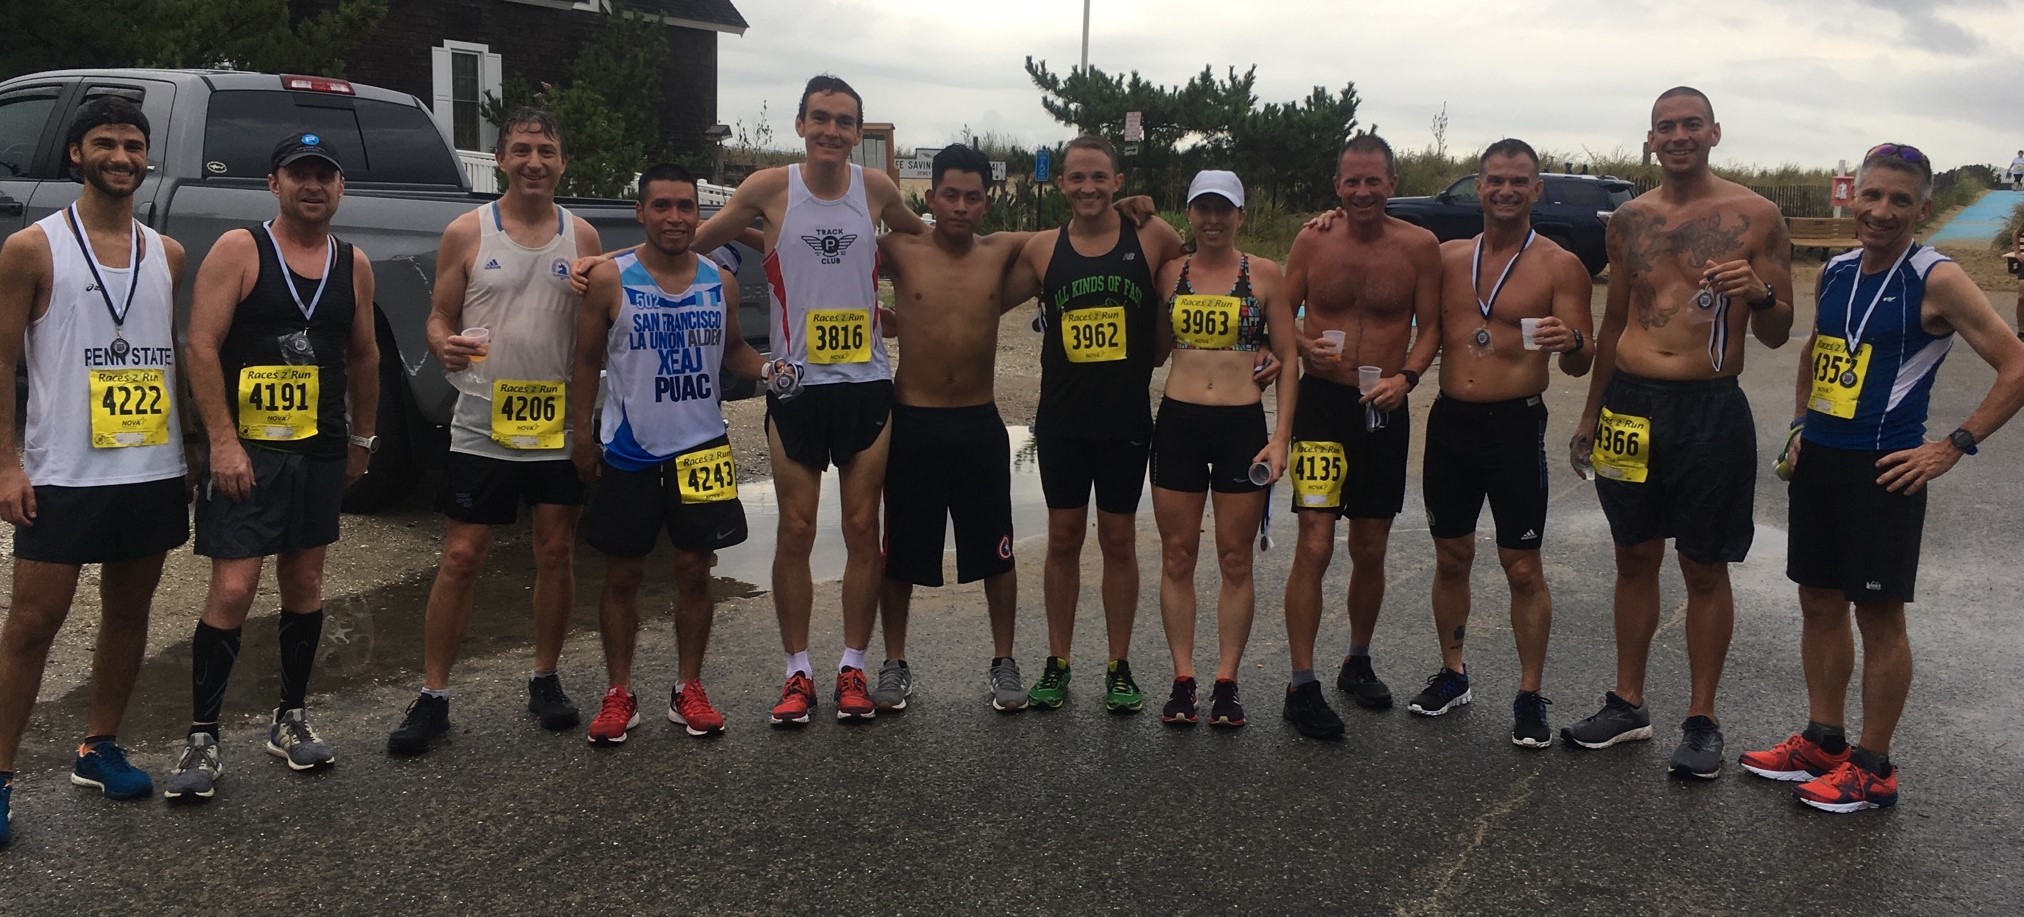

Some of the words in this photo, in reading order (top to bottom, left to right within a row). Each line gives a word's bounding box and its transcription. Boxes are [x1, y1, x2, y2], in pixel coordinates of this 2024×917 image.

[816, 228, 844, 236] TRACK
[635, 293, 660, 310] 502
[1055, 286, 1069, 311] ALL
[1072, 275, 1104, 298] KINDS
[1107, 275, 1121, 292] OF
[1181, 298, 1205, 307] Races
[1215, 300, 1233, 308] Run
[633, 313, 660, 333] SAN
[662, 310, 722, 332] FRANCISCO
[813, 313, 839, 322] Races
[848, 313, 865, 322] Run
[1068, 313, 1092, 323] Races
[1101, 311, 1119, 320] Run
[1181, 309, 1229, 336] 3963
[629, 331, 647, 350] LA
[815, 324, 863, 351] 3816
[1071, 322, 1119, 350] 3962
[84, 347, 127, 367] PENN
[132, 347, 173, 366] STATE
[657, 346, 703, 375] XEAJ
[98, 373, 129, 382] Races
[247, 370, 279, 380] Races
[290, 370, 312, 380] Run
[249, 382, 309, 411] 4191
[500, 384, 529, 393] Races
[539, 384, 558, 393] Run
[655, 373, 712, 403] PUAC
[102, 386, 162, 416] 4222
[501, 395, 556, 422] 4206
[1624, 419, 1644, 430] Run
[683, 455, 708, 467] Races
[1295, 455, 1341, 482] 4135
[688, 460, 733, 493] 4243
